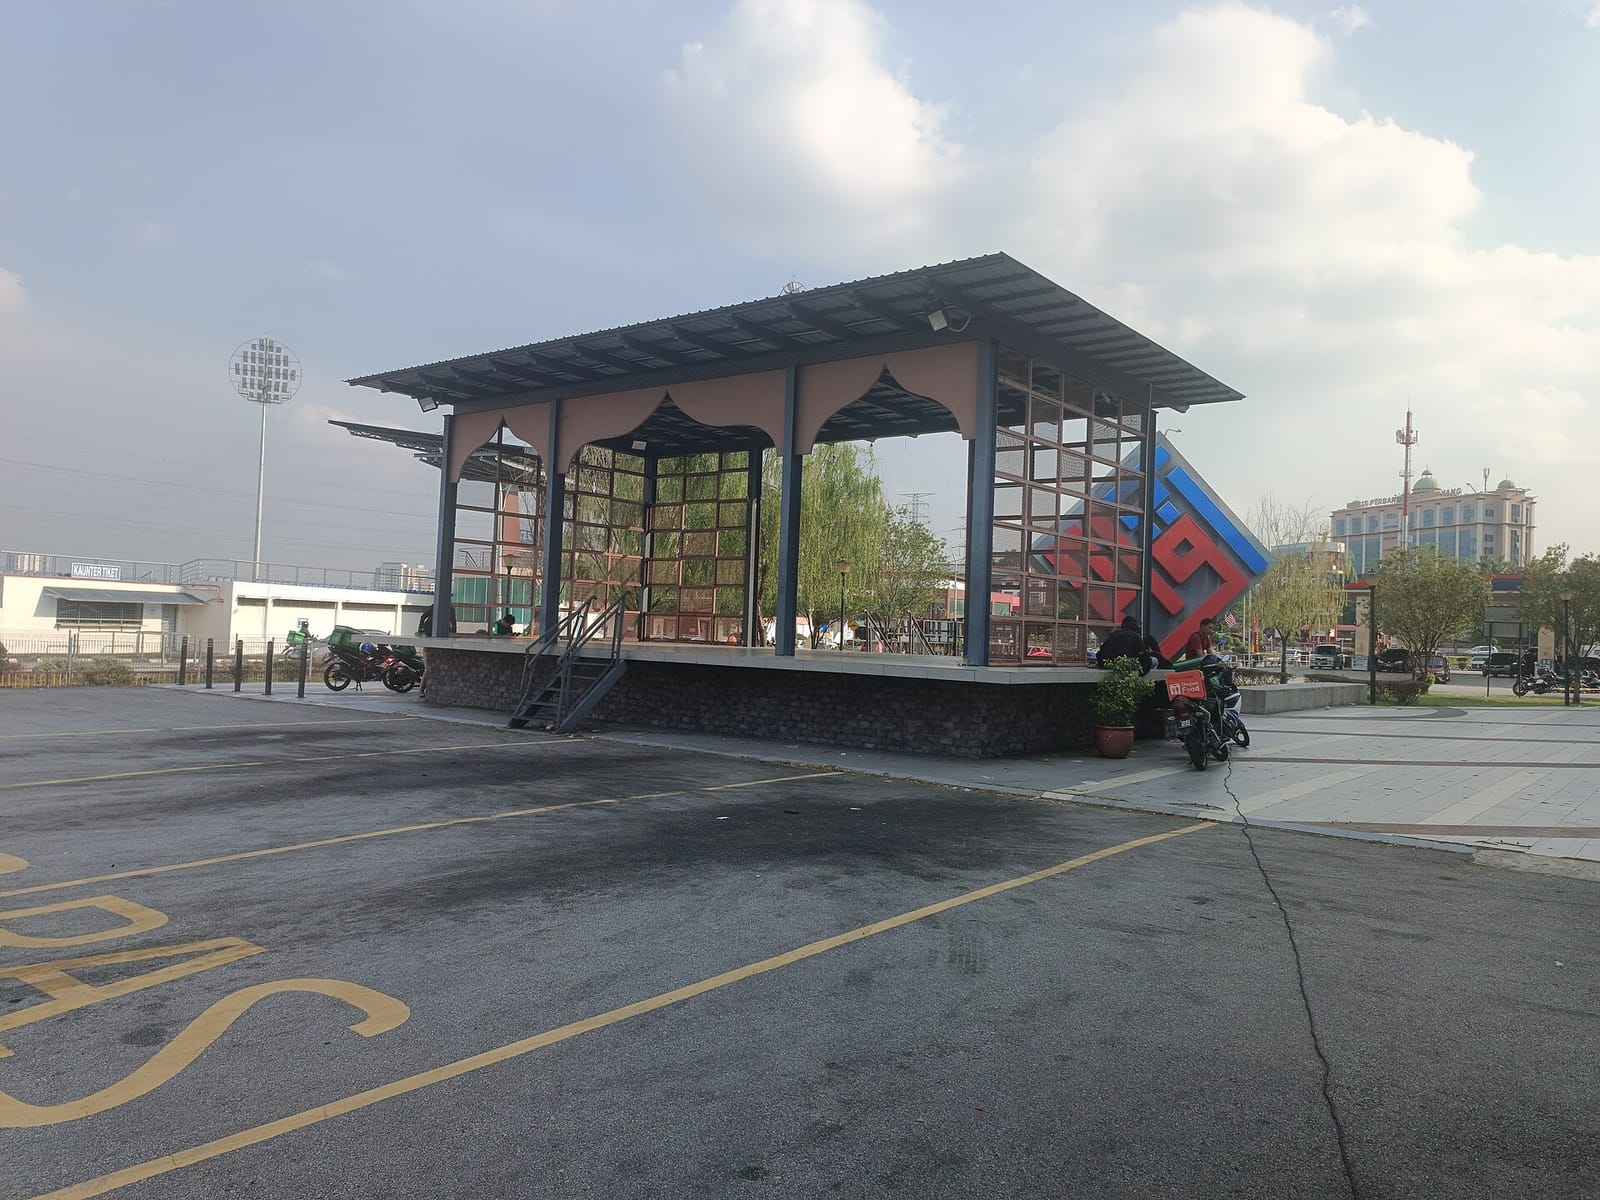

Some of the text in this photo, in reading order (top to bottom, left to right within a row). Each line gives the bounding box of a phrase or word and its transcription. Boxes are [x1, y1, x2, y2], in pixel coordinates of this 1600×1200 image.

[73, 564, 119, 579] KAUNTER TIKET
[1181, 685, 1200, 694] Food
